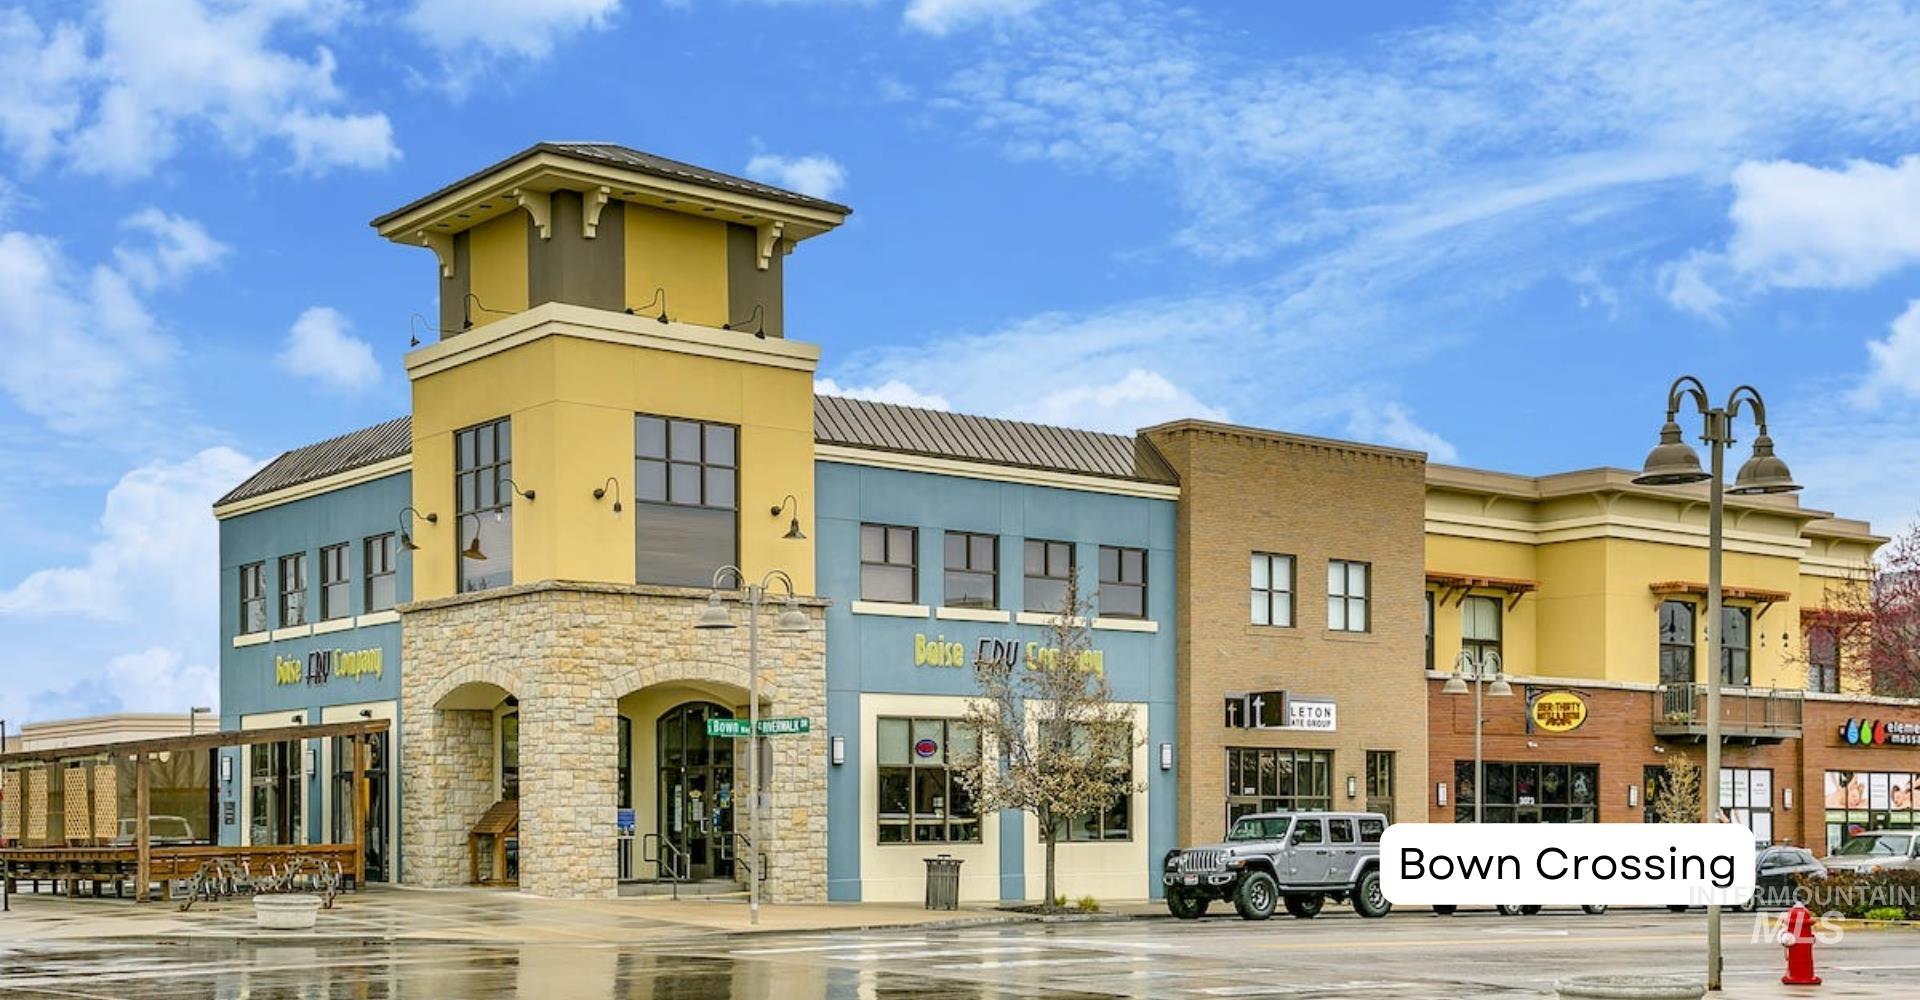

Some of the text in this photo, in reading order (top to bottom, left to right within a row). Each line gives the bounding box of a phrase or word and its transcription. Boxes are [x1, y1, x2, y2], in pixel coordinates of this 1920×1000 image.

[276, 647, 383, 685] Boise FRY Company
[915, 633, 1104, 680] Boise FRY Comany
[1290, 707, 1331, 718] LETON
[713, 720, 739, 733] Bown
